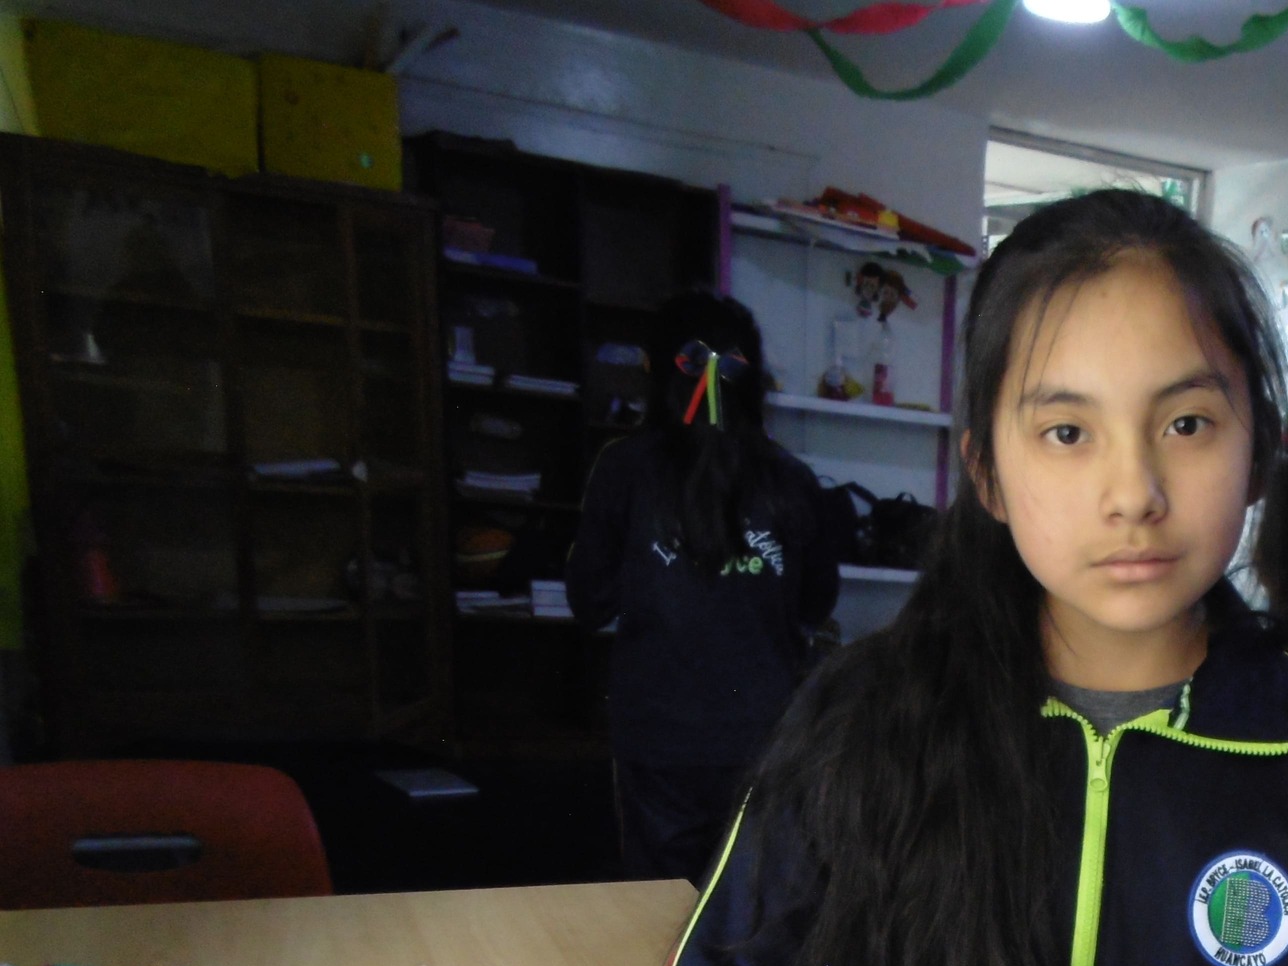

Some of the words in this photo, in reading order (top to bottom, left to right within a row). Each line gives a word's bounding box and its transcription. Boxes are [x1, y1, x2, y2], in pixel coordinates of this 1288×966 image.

[1206, 863, 1229, 886] BRYCE
[1235, 858, 1263, 873] ISABEL
[1262, 865, 1273, 879] LA
